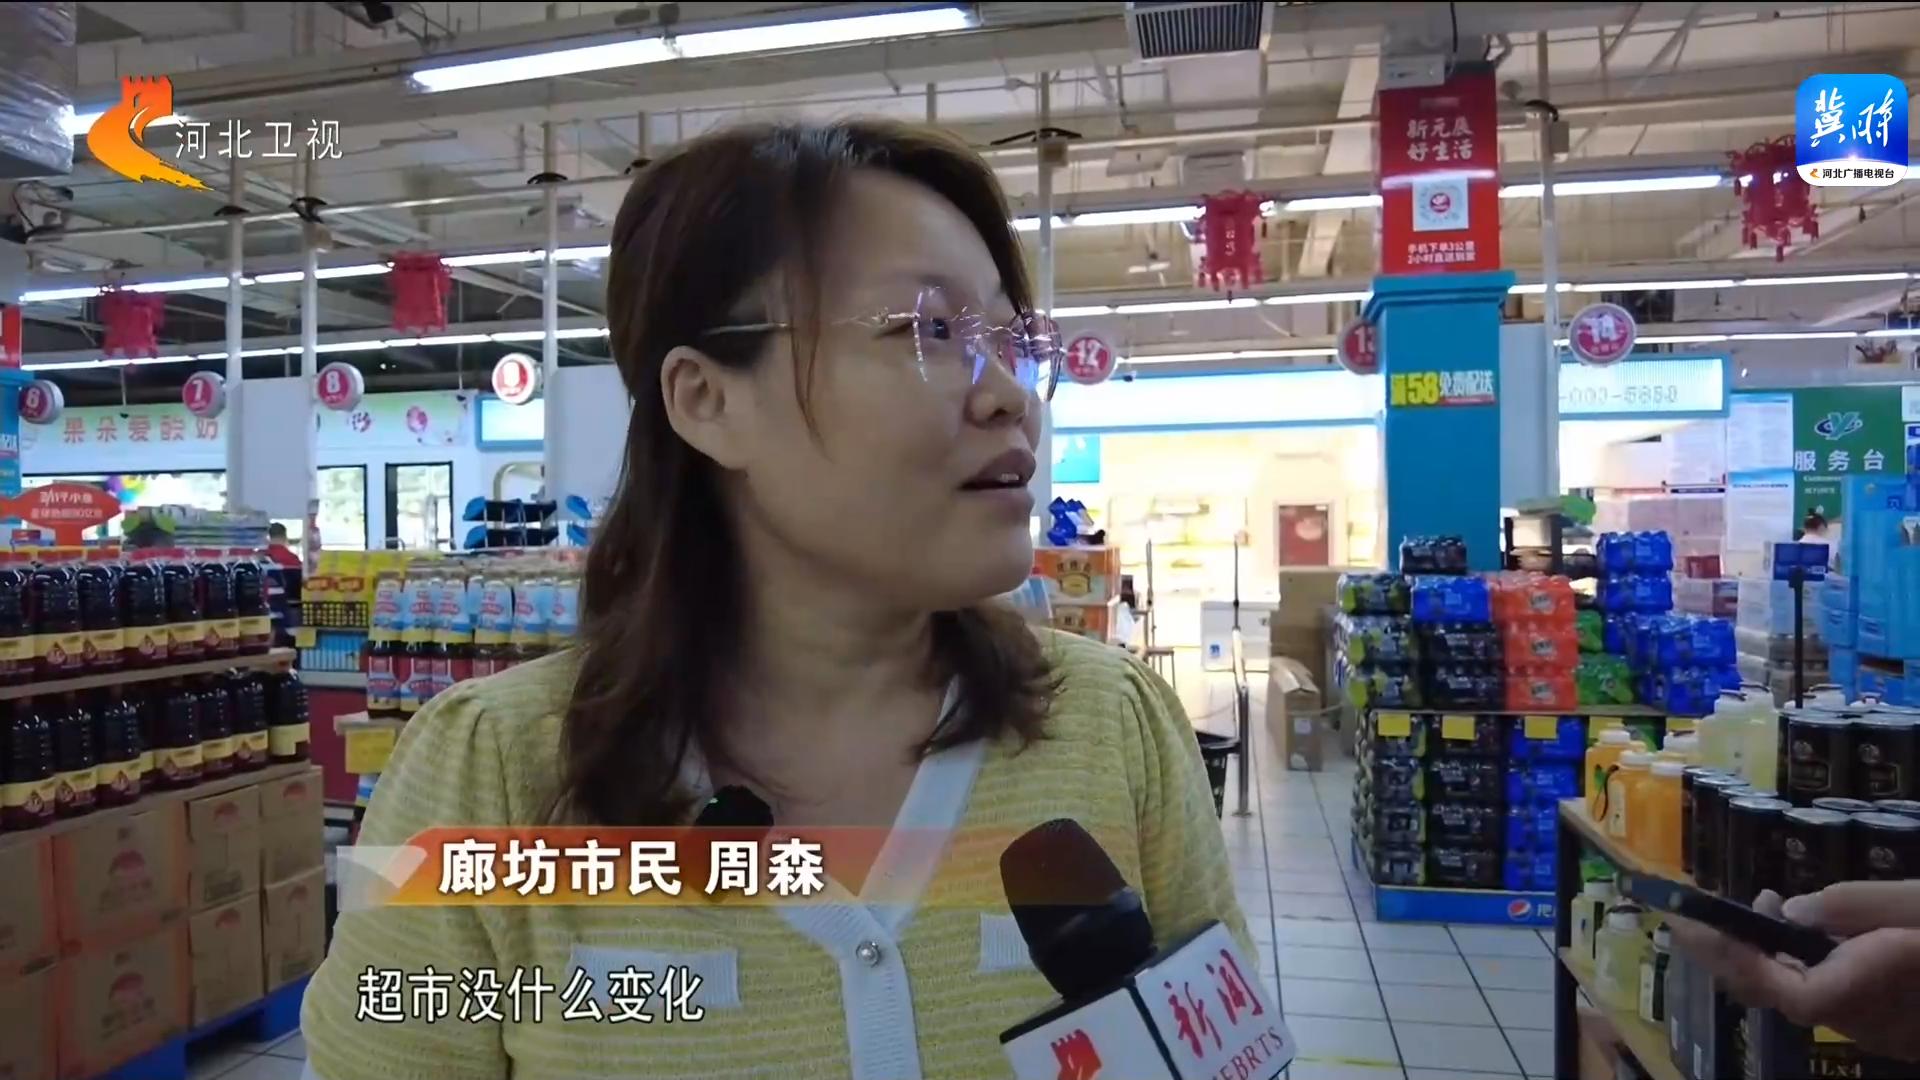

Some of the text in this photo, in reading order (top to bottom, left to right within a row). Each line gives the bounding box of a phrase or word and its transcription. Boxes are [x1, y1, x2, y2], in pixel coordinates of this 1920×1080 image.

[1406, 140, 1474, 162] 好生活
[1076, 339, 1099, 367] 12
[192, 379, 205, 401] 7
[326, 370, 340, 393] 8
[26, 387, 40, 408] 6
[1794, 448, 1885, 471] 服务台
[1212, 1026, 1284, 1080] EBRTS
